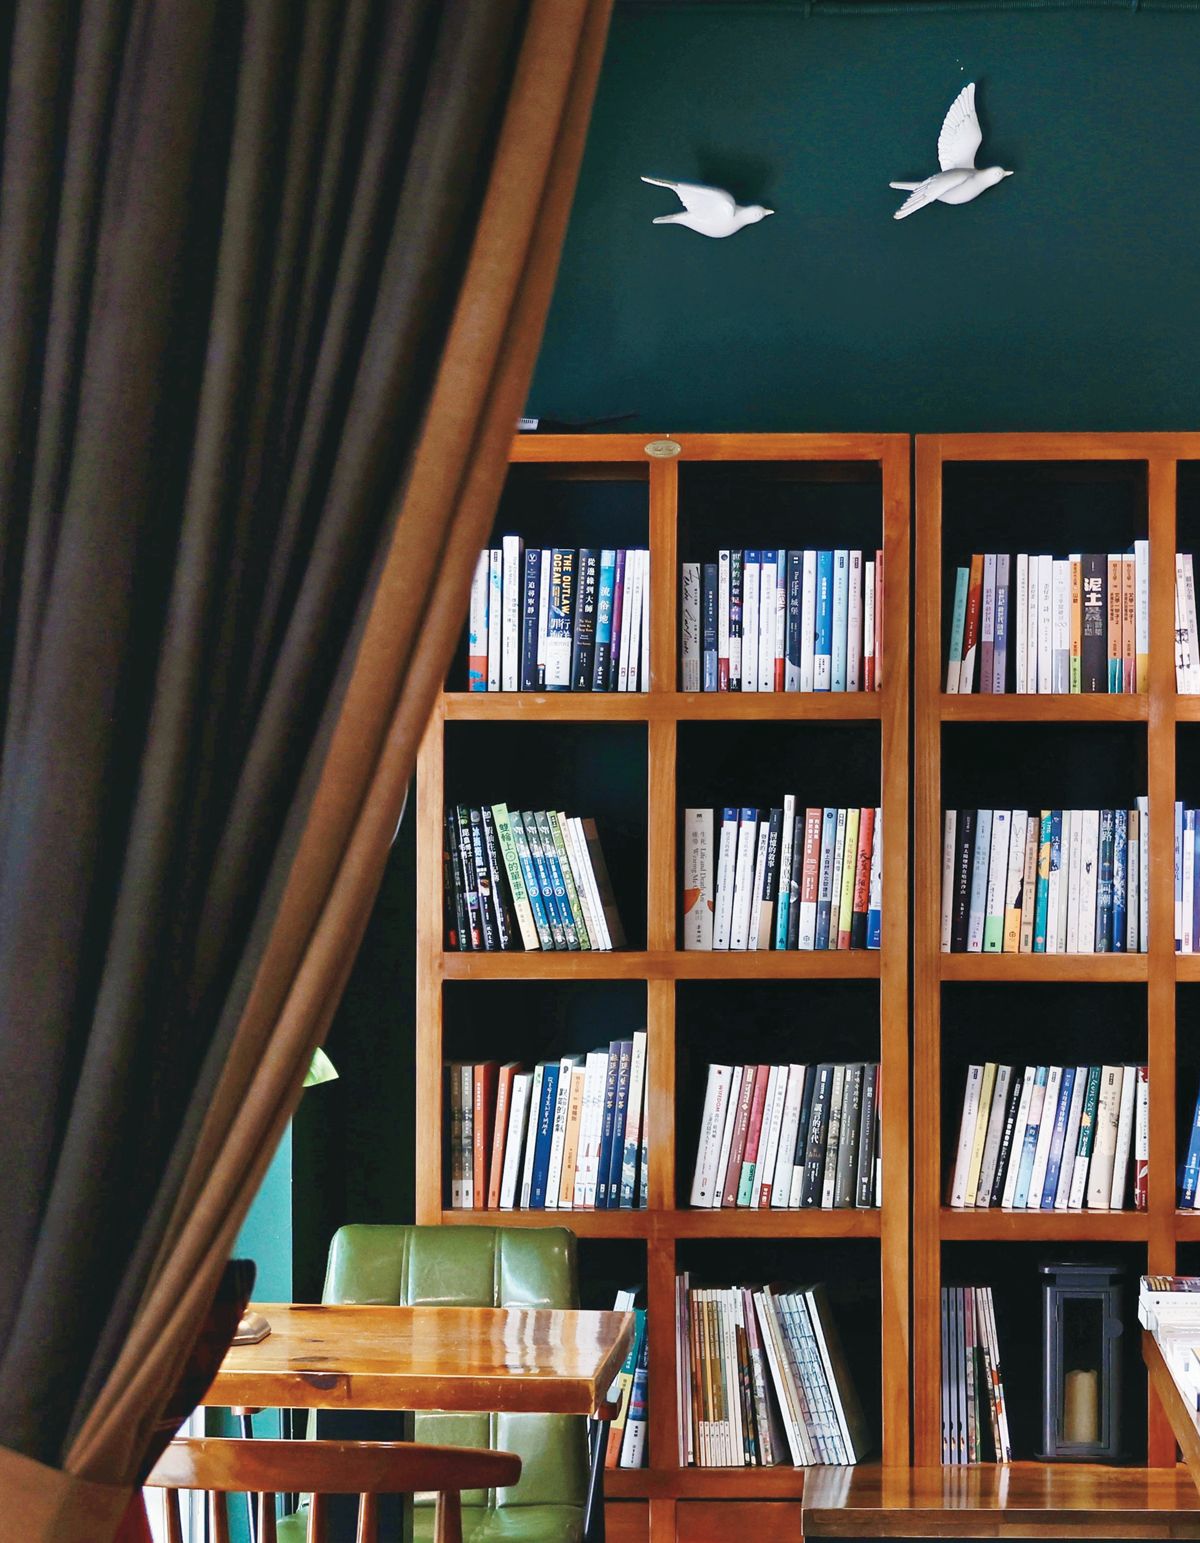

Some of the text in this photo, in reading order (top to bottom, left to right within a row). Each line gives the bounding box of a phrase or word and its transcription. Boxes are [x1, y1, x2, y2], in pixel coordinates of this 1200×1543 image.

[553, 554, 572, 615] THE OUTLAW OCEAN
[1084, 577, 1103, 607] 泥土
[599, 586, 611, 625] 流俗地
